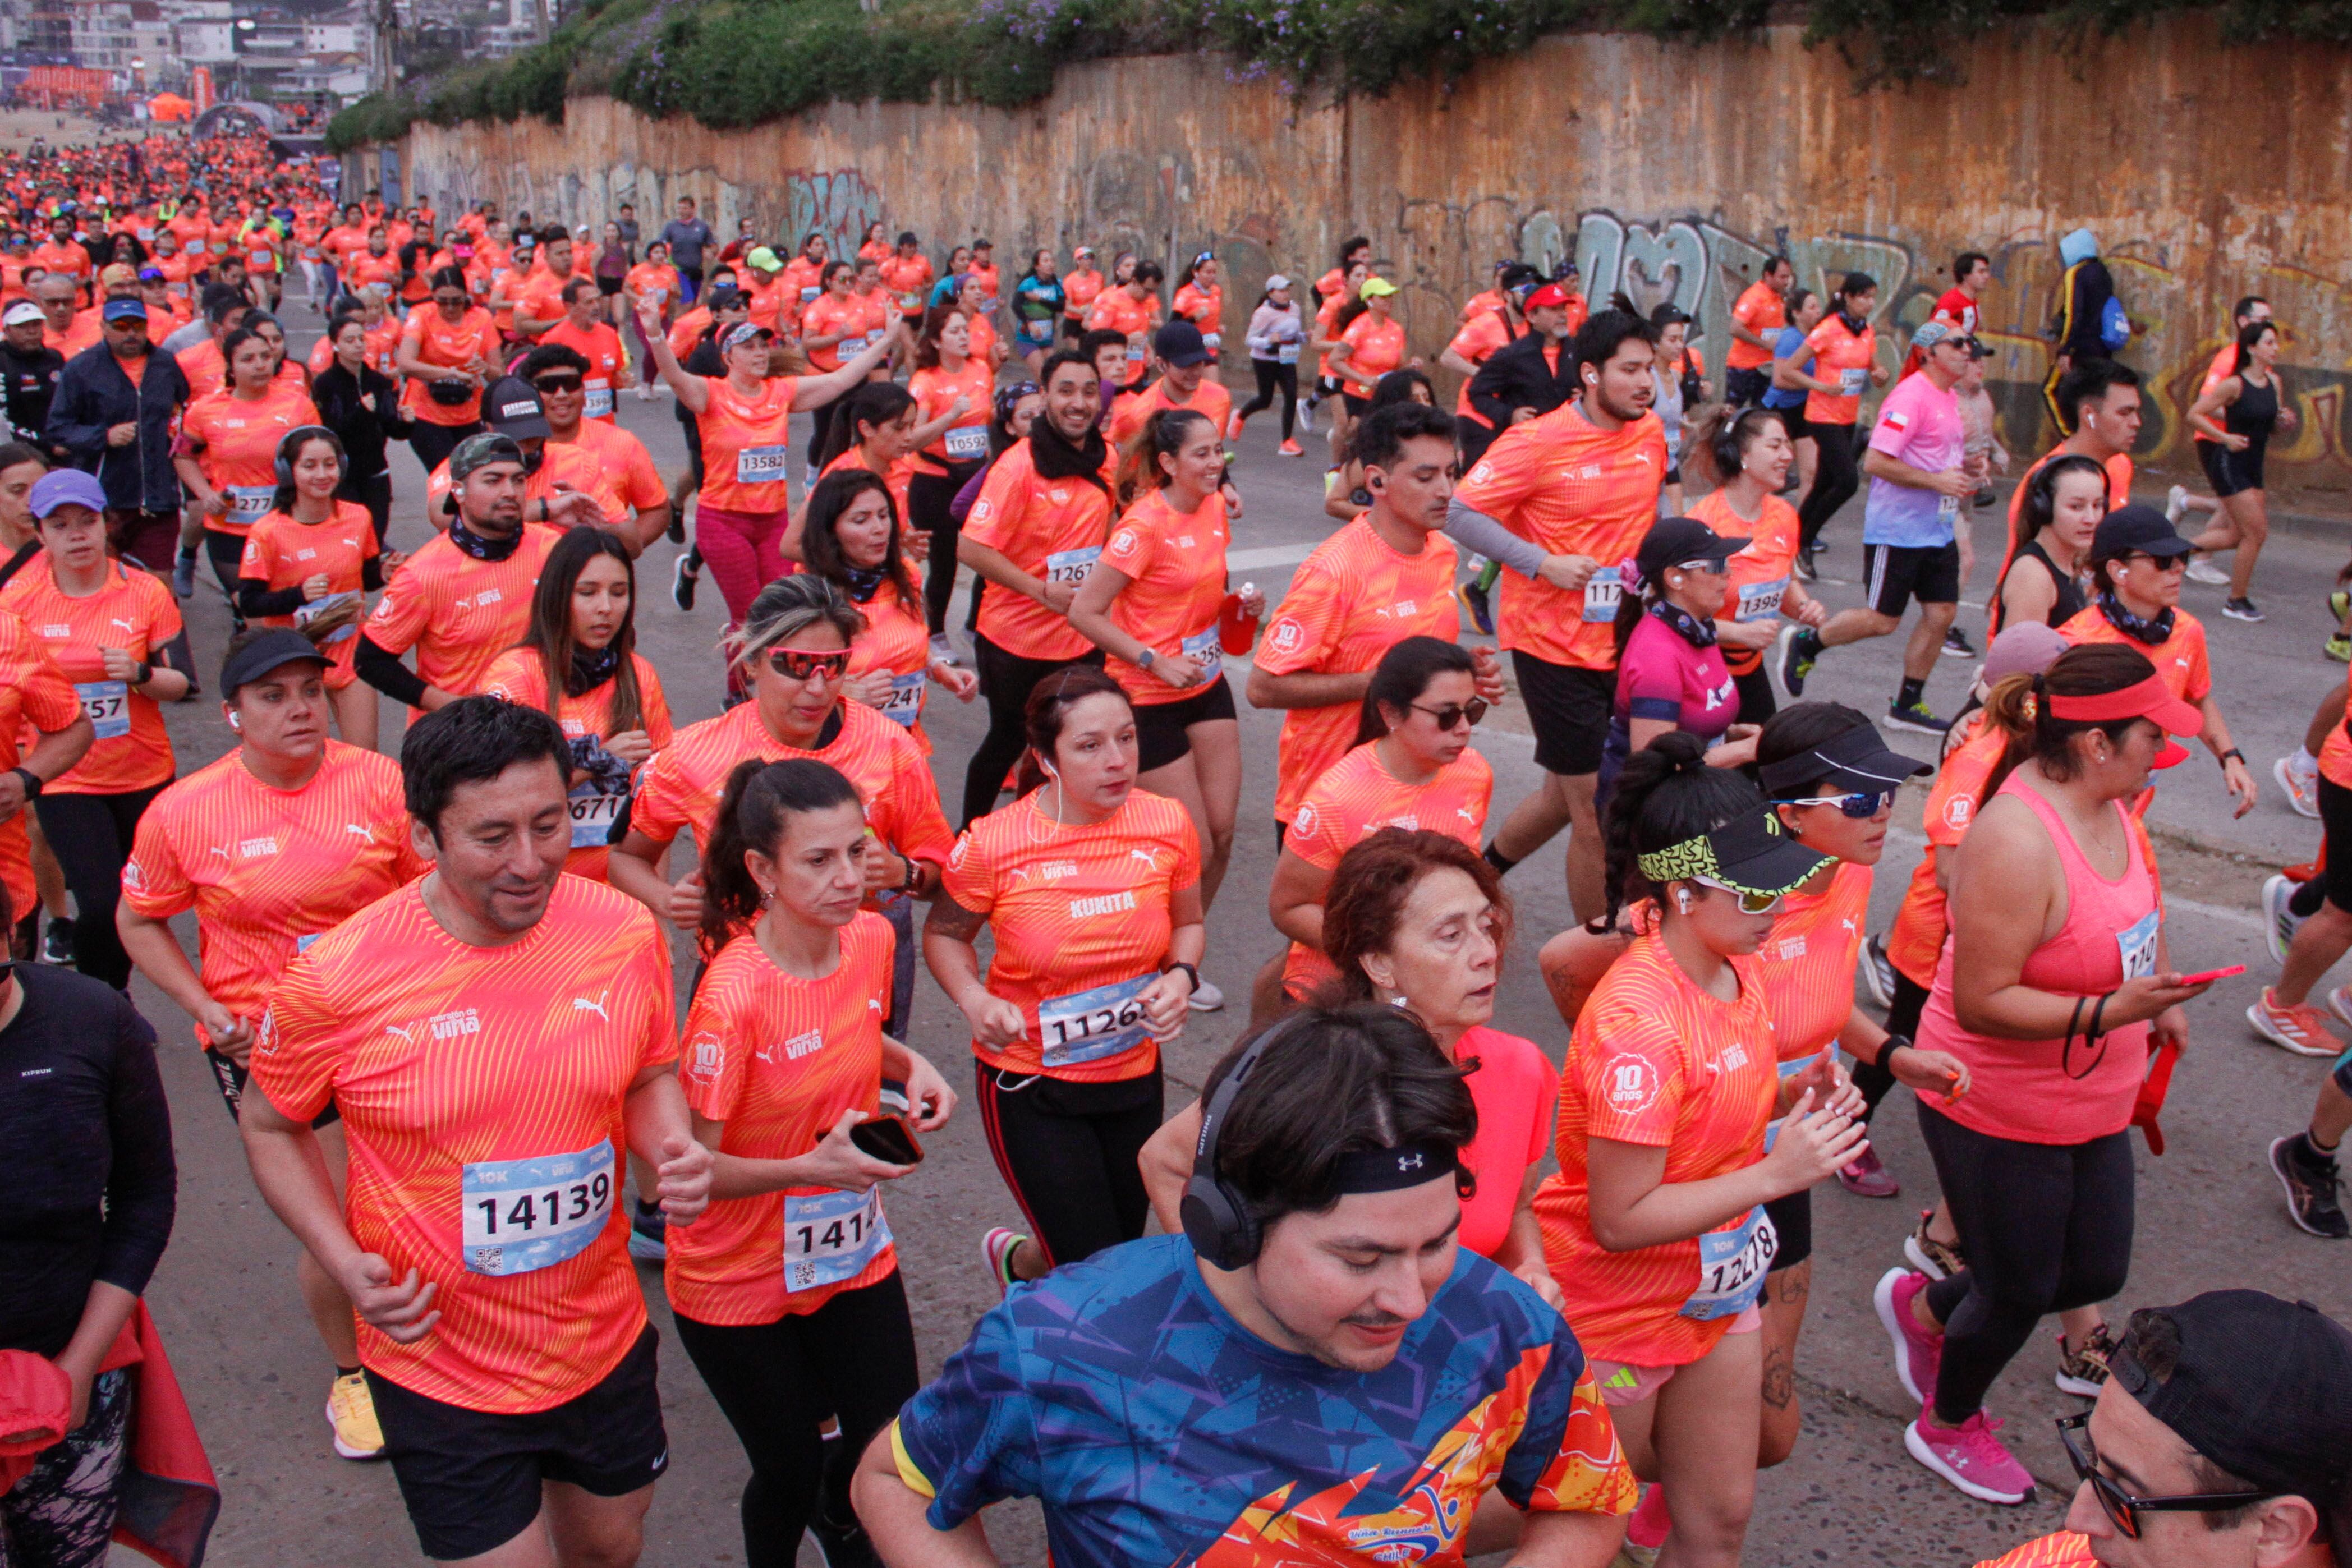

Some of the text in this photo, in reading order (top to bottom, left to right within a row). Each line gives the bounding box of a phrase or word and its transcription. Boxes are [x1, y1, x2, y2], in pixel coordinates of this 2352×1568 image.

[950, 435, 986, 450] 10592
[743, 454, 783, 470] 13582
[1070, 891, 1136, 918] KUKITA
[695, 1043, 718, 1067] 10
[1614, 1065, 1642, 1091] 10
[1198, 1114, 1212, 1156] PHILIPS
[478, 1172, 609, 1235] 14139
[1373, 1548, 1412, 1562] CHILE
